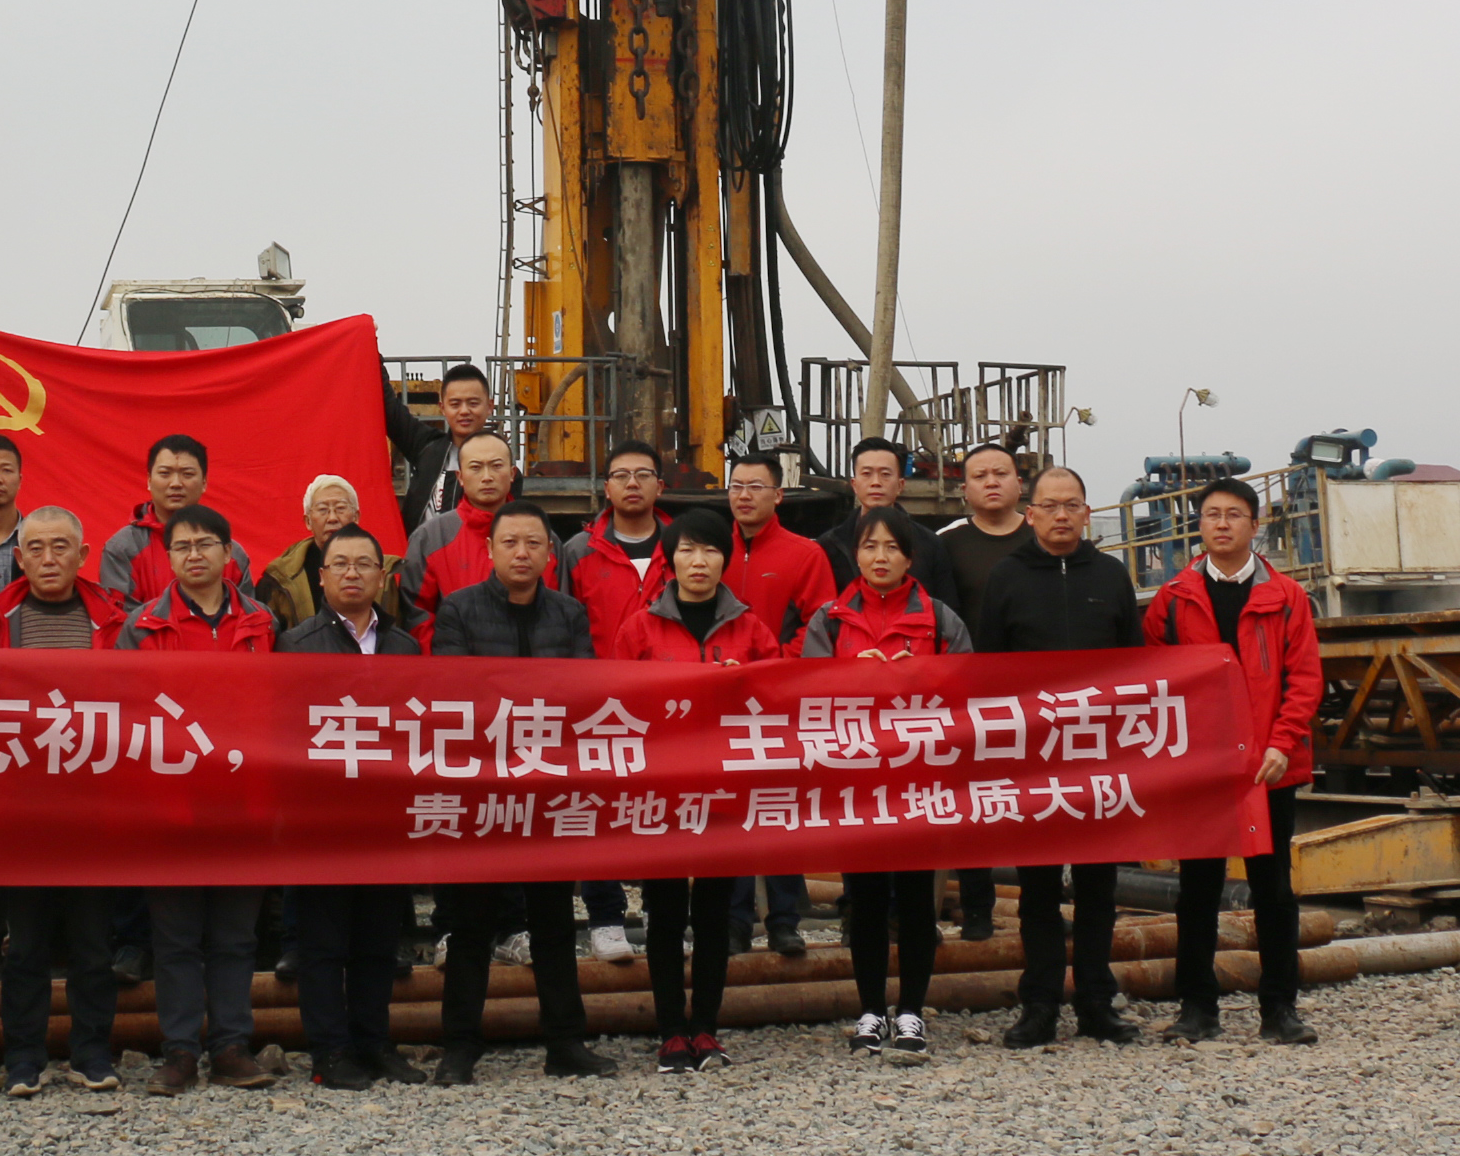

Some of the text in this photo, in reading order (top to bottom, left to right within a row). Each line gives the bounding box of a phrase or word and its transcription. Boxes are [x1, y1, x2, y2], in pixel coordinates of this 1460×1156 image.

[406, 774, 1146, 838] 贵州省地矿局111地质大队
